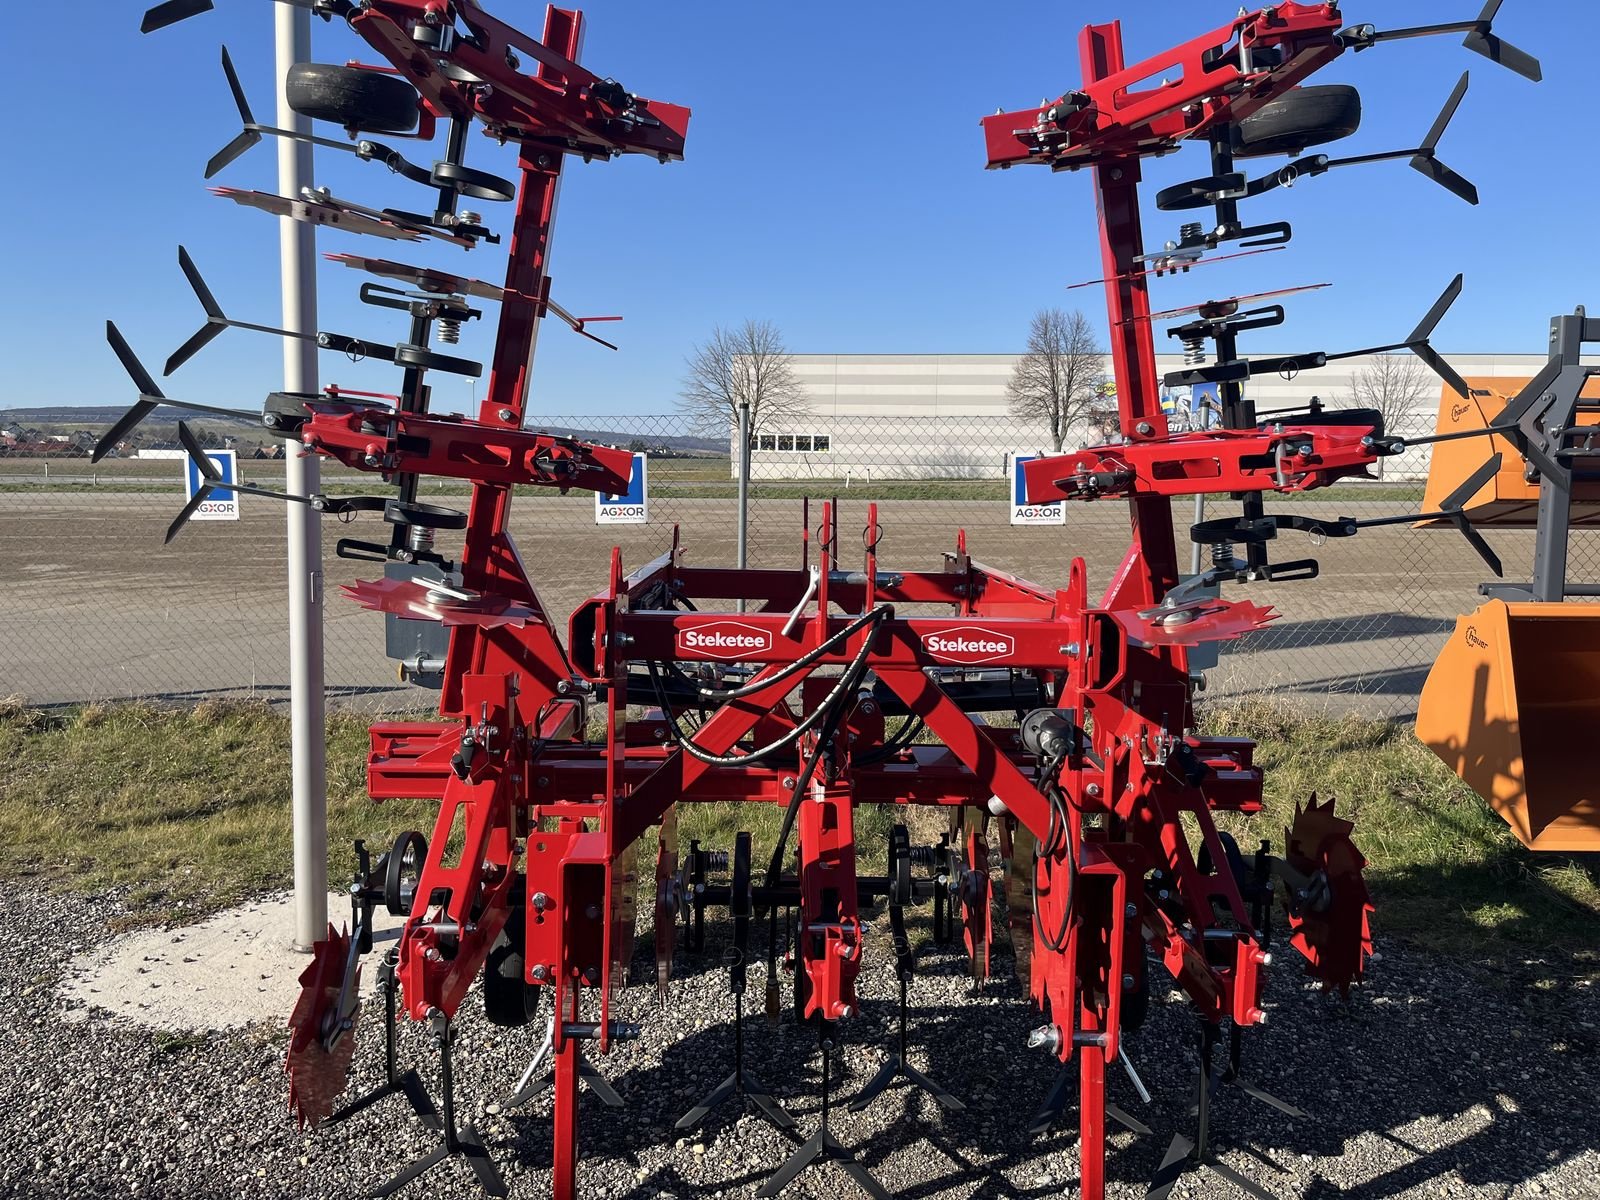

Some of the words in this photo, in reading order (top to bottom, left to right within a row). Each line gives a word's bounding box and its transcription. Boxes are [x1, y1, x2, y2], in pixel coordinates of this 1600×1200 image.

[600, 507, 644, 516] AGXOR
[1015, 508, 1061, 518] AGXOR
[685, 631, 765, 647] Steketee
[928, 636, 1007, 652] Steketee
[1468, 630, 1489, 649] hauer
